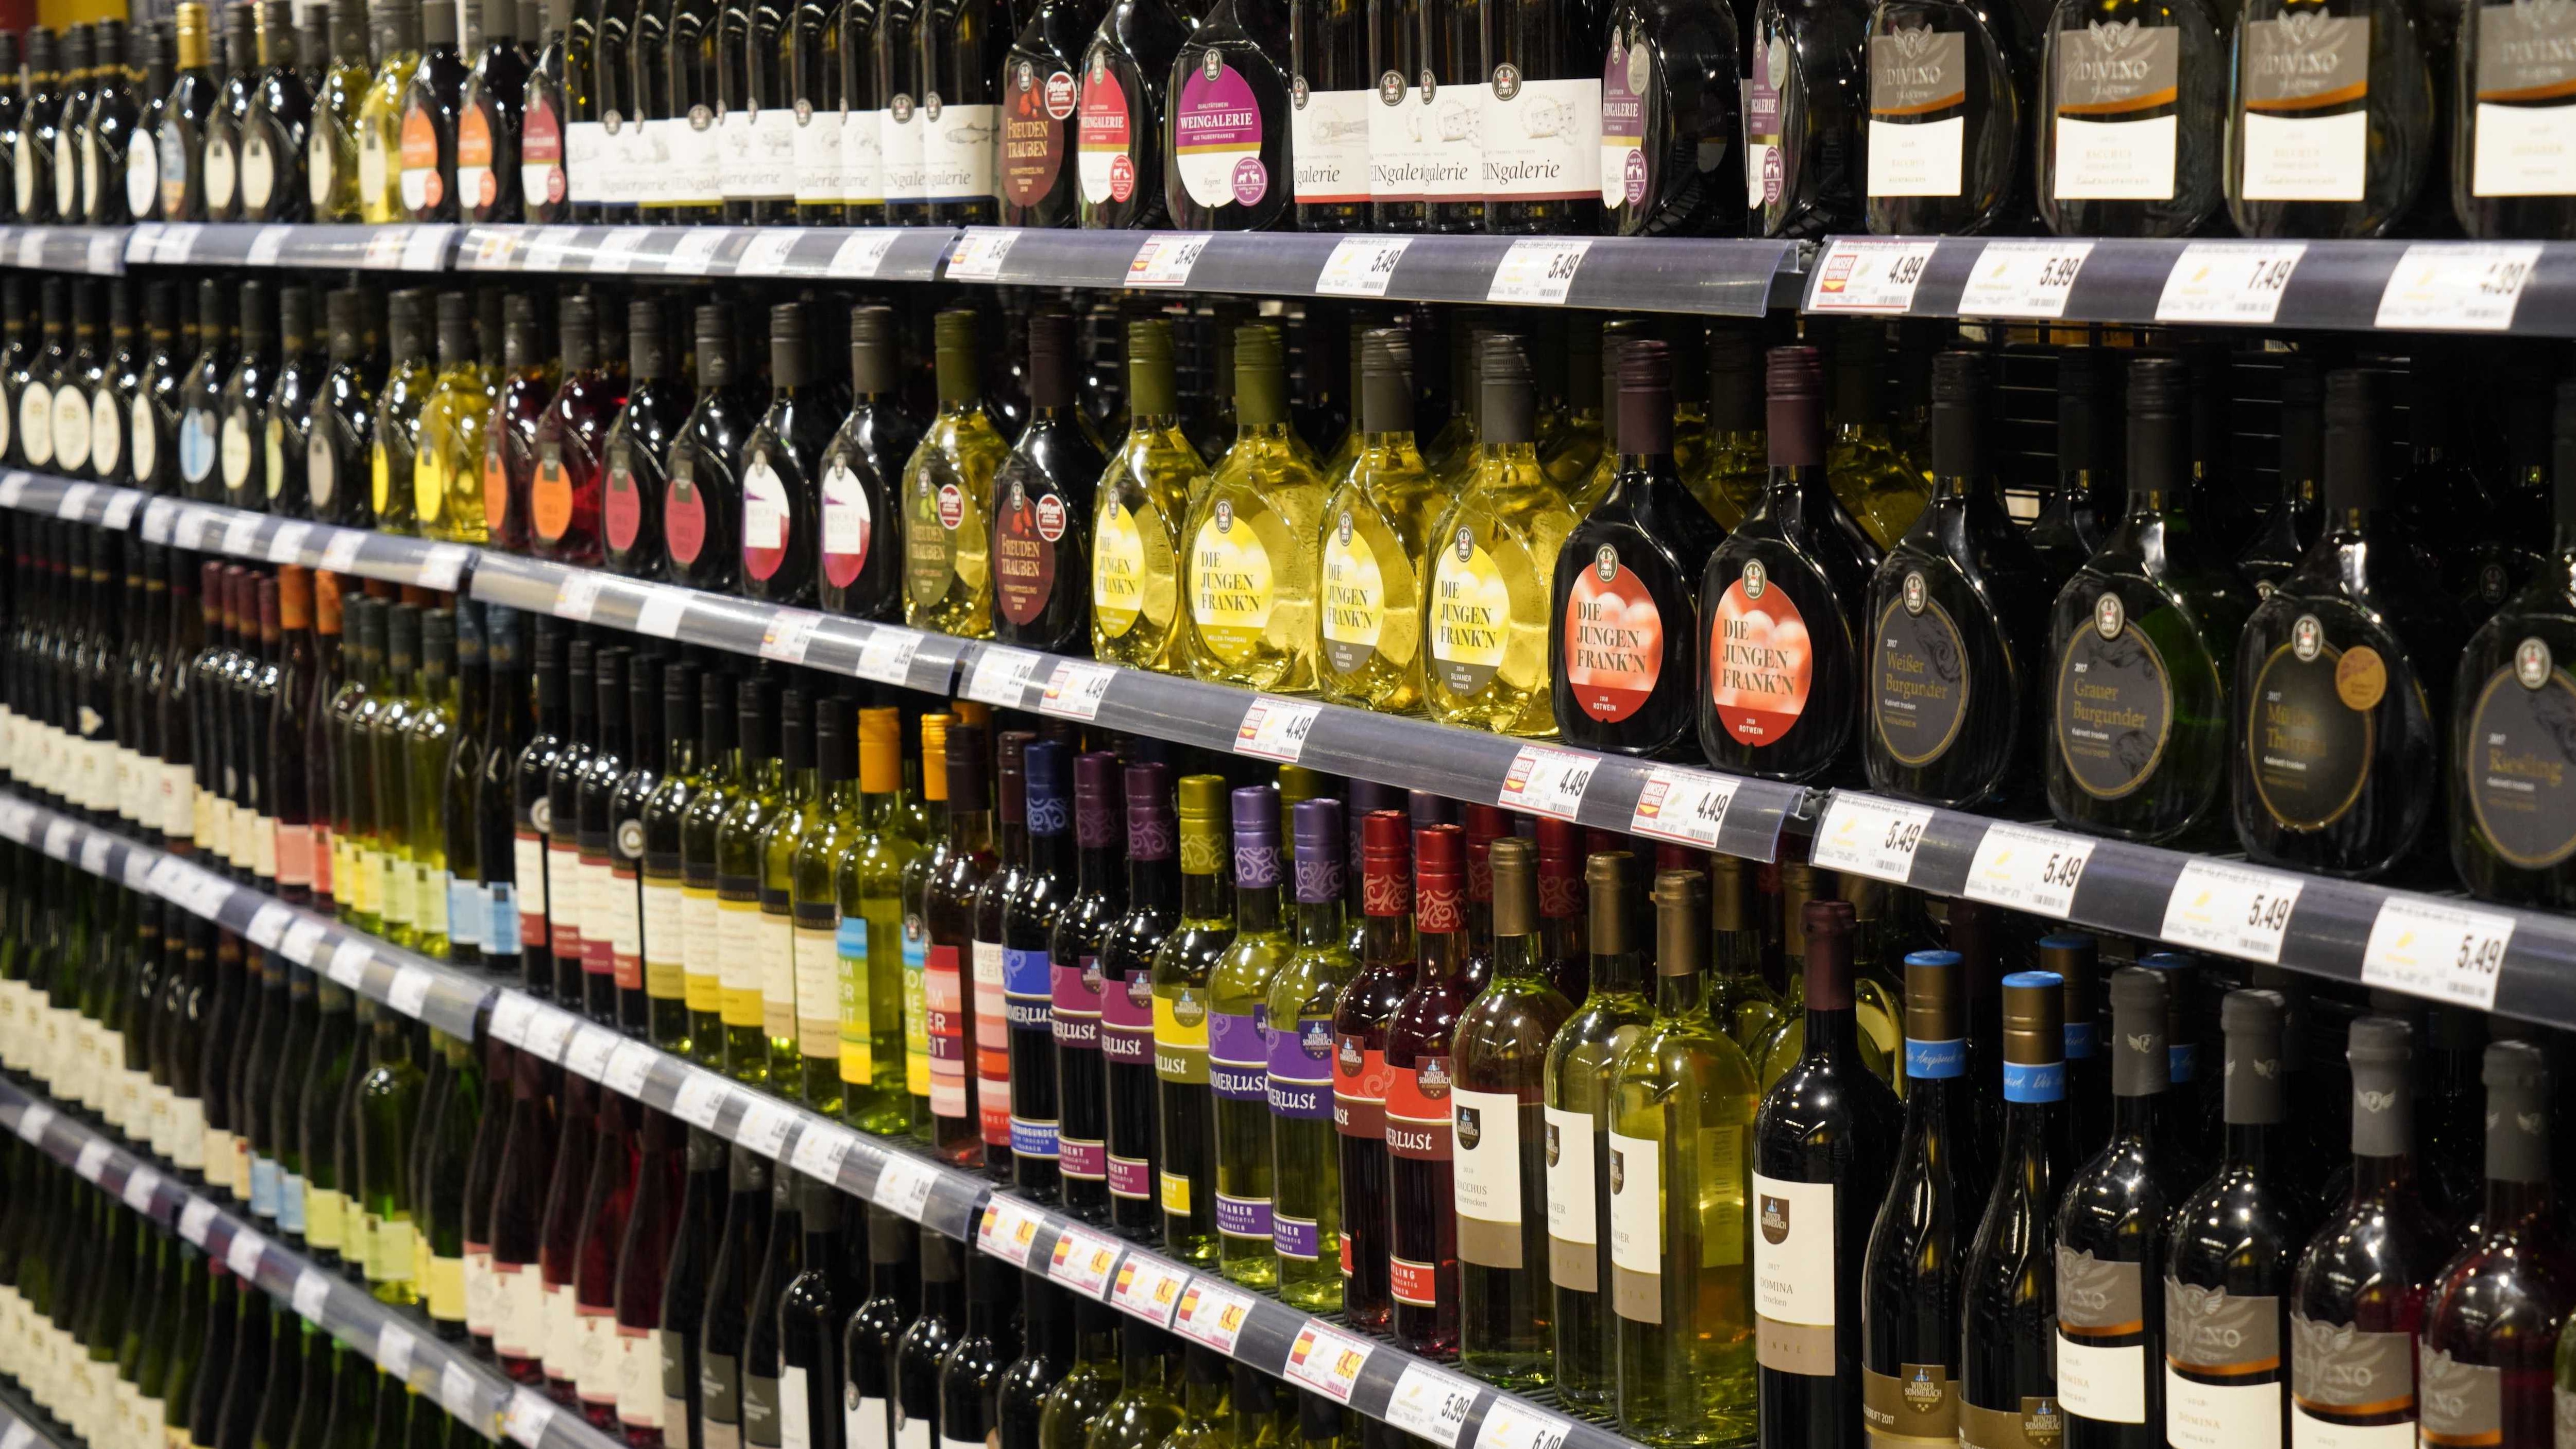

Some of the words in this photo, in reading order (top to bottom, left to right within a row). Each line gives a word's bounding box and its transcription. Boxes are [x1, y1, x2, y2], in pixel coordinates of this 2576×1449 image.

[2080, 60, 2148, 81] DIVINO
[2266, 53, 2338, 75] DIVINO
[1886, 66, 1942, 85] DIVINO
[1180, 113, 1253, 129] WEINGALERIE
[1008, 141, 1047, 158] TRAUBEN
[1175, 244, 1202, 265] 5.49
[1371, 250, 1401, 272] 5.49
[1829, 257, 1853, 269] UNSER
[1548, 253, 1579, 279] 5.49
[1889, 256, 1924, 284] 4.99
[2039, 258, 2079, 286] 5.99
[2248, 261, 2291, 291] 7.49
[1100, 536, 1112, 552] DIE
[1002, 558, 1040, 577] TRAUBEN
[1099, 556, 1131, 573] JUNGEN
[1200, 551, 1221, 568] DIE
[1201, 572, 1254, 591] JUNGEN
[1328, 562, 1342, 582] DIE
[1098, 576, 1136, 596] FRANK'N
[1328, 585, 1368, 606] JUNGEN
[1440, 580, 1460, 599] DIE
[1201, 593, 1260, 612] FRANK'N
[1577, 601, 1602, 622] DIE
[1328, 607, 1372, 629] FRANK'N
[1440, 603, 1492, 625] JUNGEN
[1440, 625, 1497, 649] FRANK'N
[1577, 625, 1640, 648] JUNGEN
[1723, 619, 1749, 640] DIE
[1335, 652, 1352, 661] SILVANER
[1577, 649, 1646, 674] FRANK'N
[1722, 644, 1789, 669] JUNGEN
[1887, 651, 1925, 673] Weißer
[1450, 672, 1472, 683] SILVANER
[1452, 682, 1469, 690] TROCKEN
[1722, 669, 1795, 695] FRANK'N
[1886, 673, 1948, 700] Burgunder
[1084, 678, 1104, 700] 4.49
[2074, 677, 2119, 701] Grauer
[1593, 702, 1616, 712] ROTWEIN
[2072, 700, 2147, 729] Burgunder
[1285, 715, 1311, 741] 4.49
[1739, 724, 1763, 735] ROTWEIN
[1560, 768, 1589, 796] 4.49
[1646, 781, 1669, 797] UNSER
[1697, 792, 1728, 821] 4.49
[1885, 821, 1921, 854] 5.49
[2043, 854, 2082, 888] 5.49
[2249, 894, 2290, 930] 5.49
[2456, 935, 2502, 974] 5.49
[1456, 1181, 1487, 1195] BACCHUS
[1762, 1218, 1787, 1230] SOMMERACH
[1765, 1212, 1781, 1221] WINZER
[1760, 1277, 1793, 1295] DOMINA
[1763, 1294, 1787, 1307] trocken
[1905, 1387, 1942, 1397] SOMMERACH
[1910, 1382, 1934, 1391] WINZER
[1442, 1393, 1470, 1423] 5.99
[2032, 1414, 2057, 1423] WINZER
[1882, 1414, 1894, 1426] 2017
[2178, 1411, 2222, 1431] DOMINA
[1533, 1429, 1562, 1449] 649
